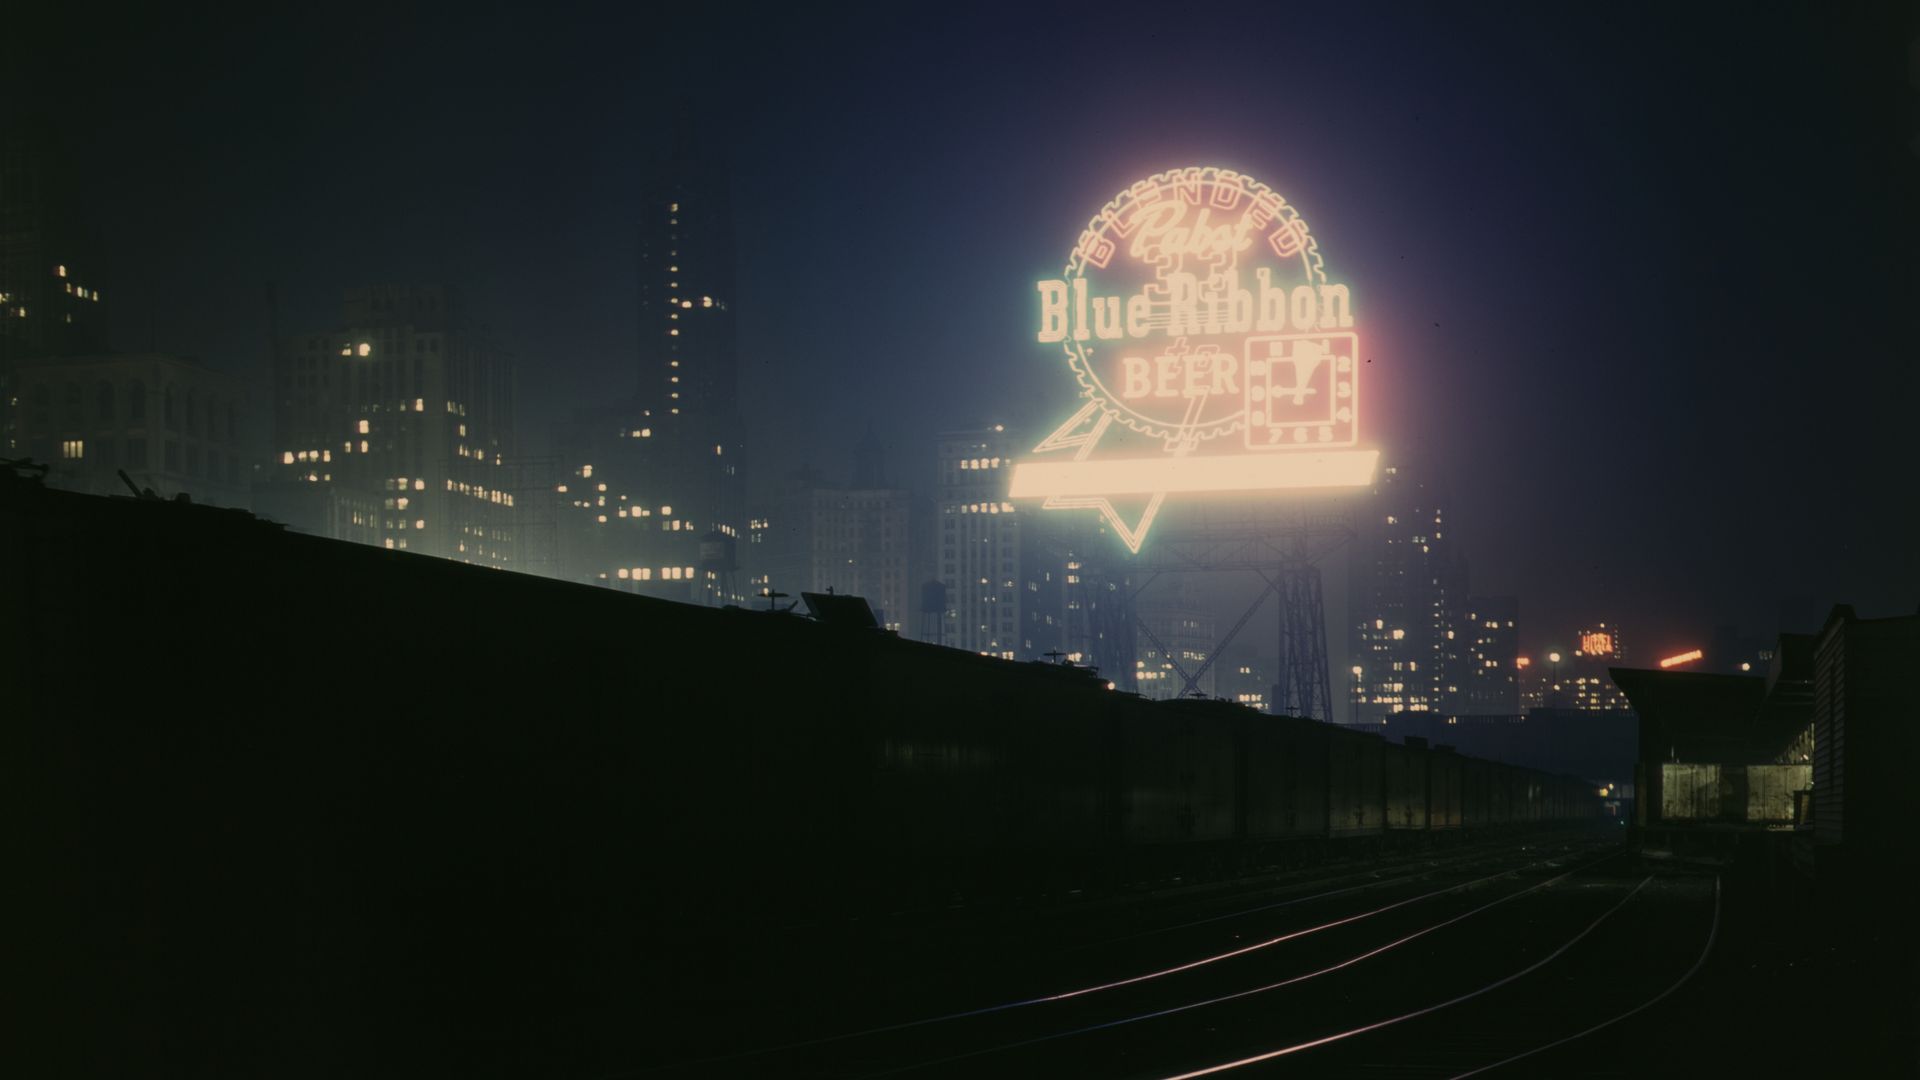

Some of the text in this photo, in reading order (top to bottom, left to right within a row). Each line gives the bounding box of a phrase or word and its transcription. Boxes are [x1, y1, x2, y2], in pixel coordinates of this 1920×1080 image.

[1078, 173, 1309, 268] BLENDED
[1130, 199, 1253, 259] Pabst
[1037, 267, 1354, 343] Blue Ribbon
[1122, 354, 1240, 399] BEER
